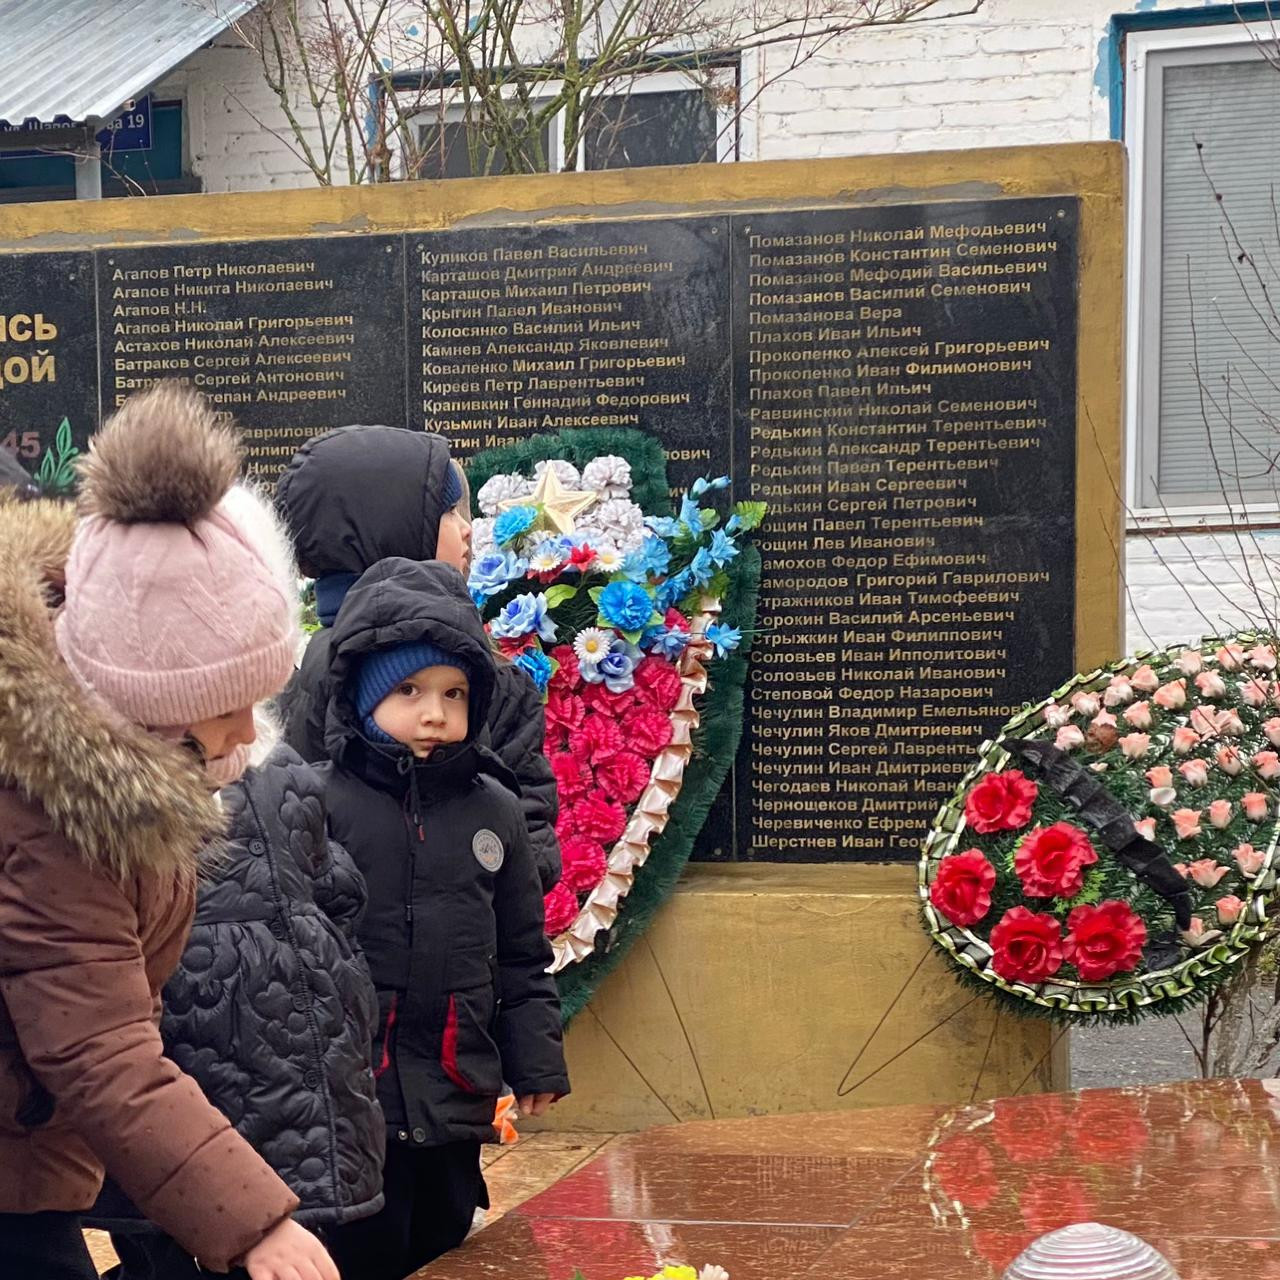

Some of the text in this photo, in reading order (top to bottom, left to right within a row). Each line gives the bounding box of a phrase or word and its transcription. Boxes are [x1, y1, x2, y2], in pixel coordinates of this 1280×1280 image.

[128, 114, 144, 128] 19
[112, 262, 315, 281] Агапов Петр Николаевич
[749, 306, 902, 325] Помазанова Вера
[114, 315, 353, 335] Агапов Николай Григорьевич
[422, 319, 642, 339] Колосянко Василий Ильич
[752, 648, 1006, 664] Соловьев Иван Ипполитович
[752, 723, 982, 740] Чечулин Яков Дмитриевич
[752, 816, 926, 832] Черевиченко Ефрем
